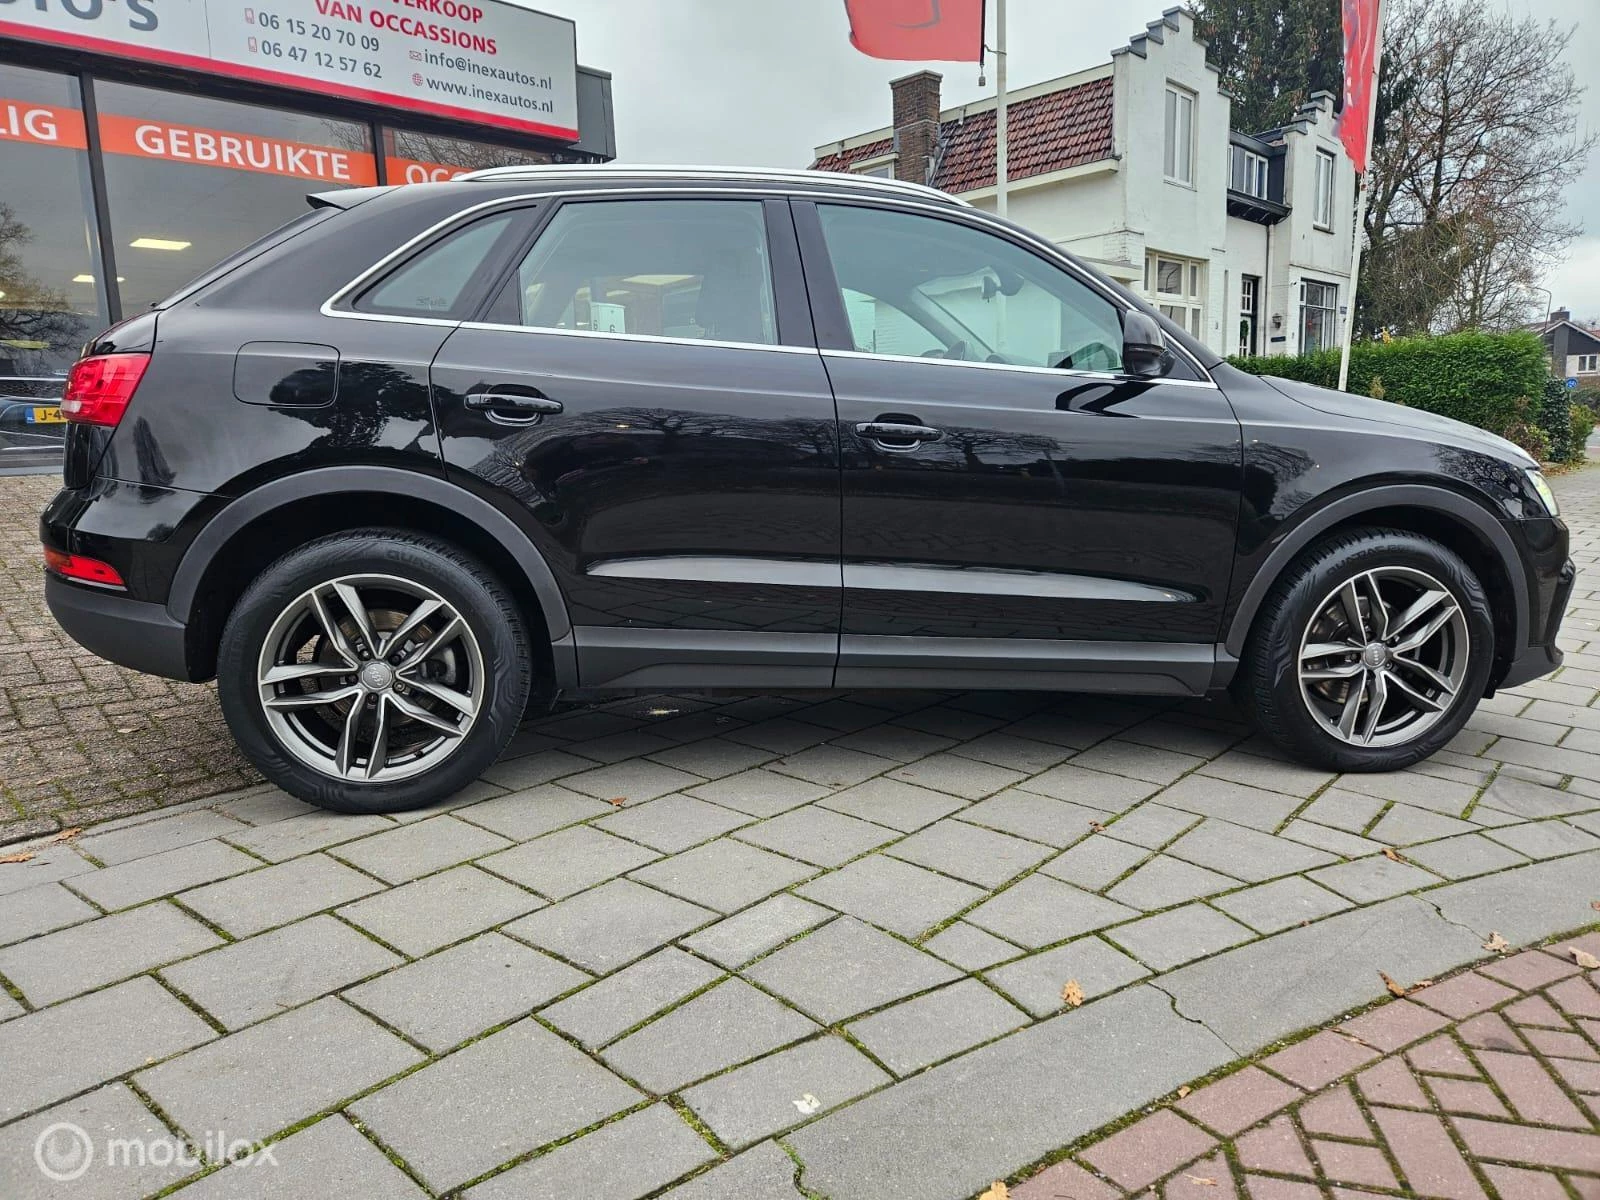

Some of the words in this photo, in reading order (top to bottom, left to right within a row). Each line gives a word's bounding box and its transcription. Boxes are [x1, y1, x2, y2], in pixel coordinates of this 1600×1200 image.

[315, 0, 362, 23] VAN
[370, 10, 497, 55] OCCASSIONS
[393, 0, 483, 23] RKOOP
[259, 12, 280, 30] 06
[286, 19, 306, 35] 15
[311, 24, 331, 41] 20
[336, 29, 356, 46] 70
[361, 35, 379, 52] 09
[262, 40, 282, 57] 06
[288, 46, 307, 62] 47
[314, 52, 334, 68] 12
[339, 56, 357, 73] 57
[363, 62, 382, 78] 62
[425, 49, 552, 90] info@inexautos.nl
[426, 77, 553, 113] www.inexautos.nl
[135, 125, 350, 179] GEBRUIKTE
